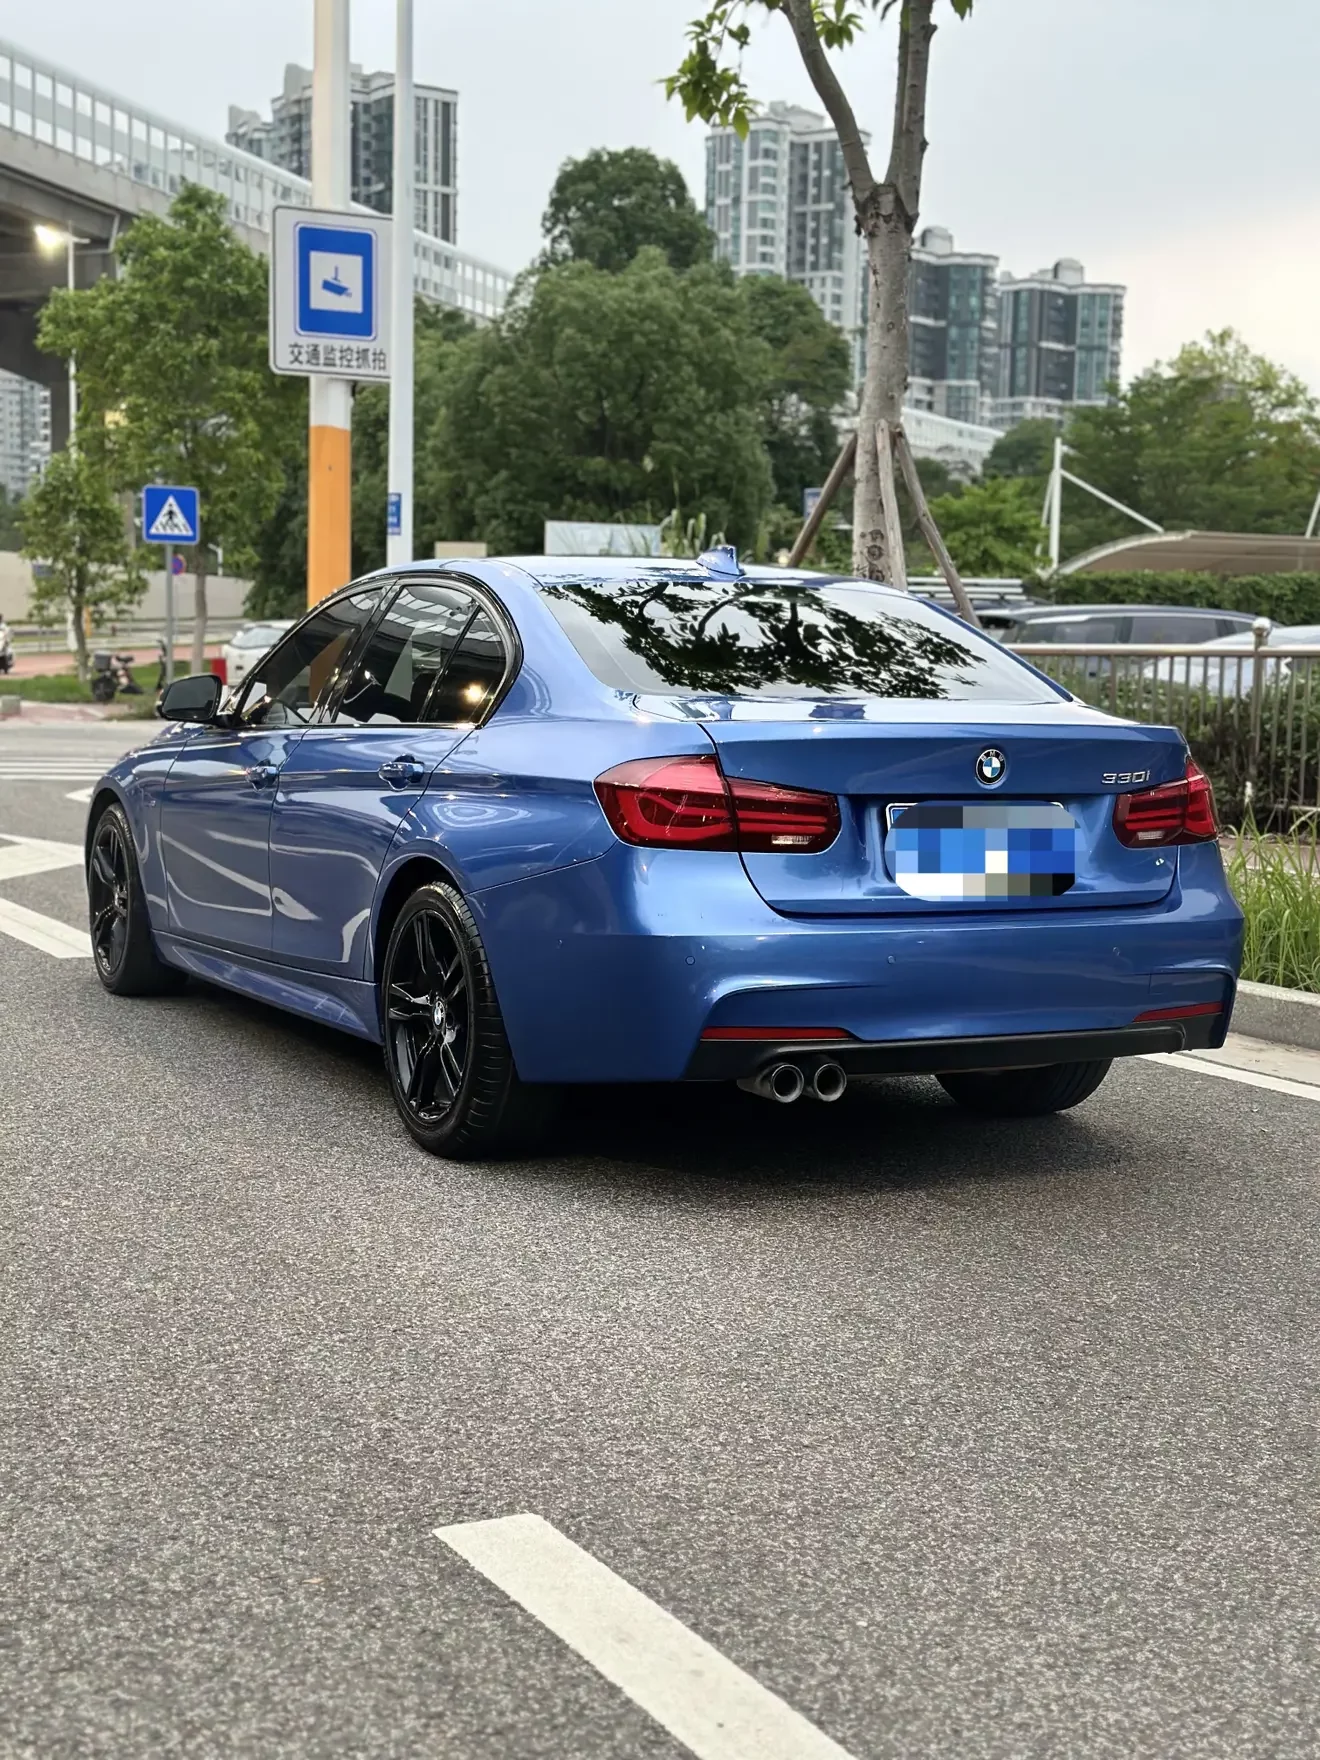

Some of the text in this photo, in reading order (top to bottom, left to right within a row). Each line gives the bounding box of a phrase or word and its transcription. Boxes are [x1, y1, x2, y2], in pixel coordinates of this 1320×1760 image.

[288, 342, 387, 371] 交通监控抓拍
[980, 751, 1004, 762] BMW
[1101, 770, 1151, 784] 330i
